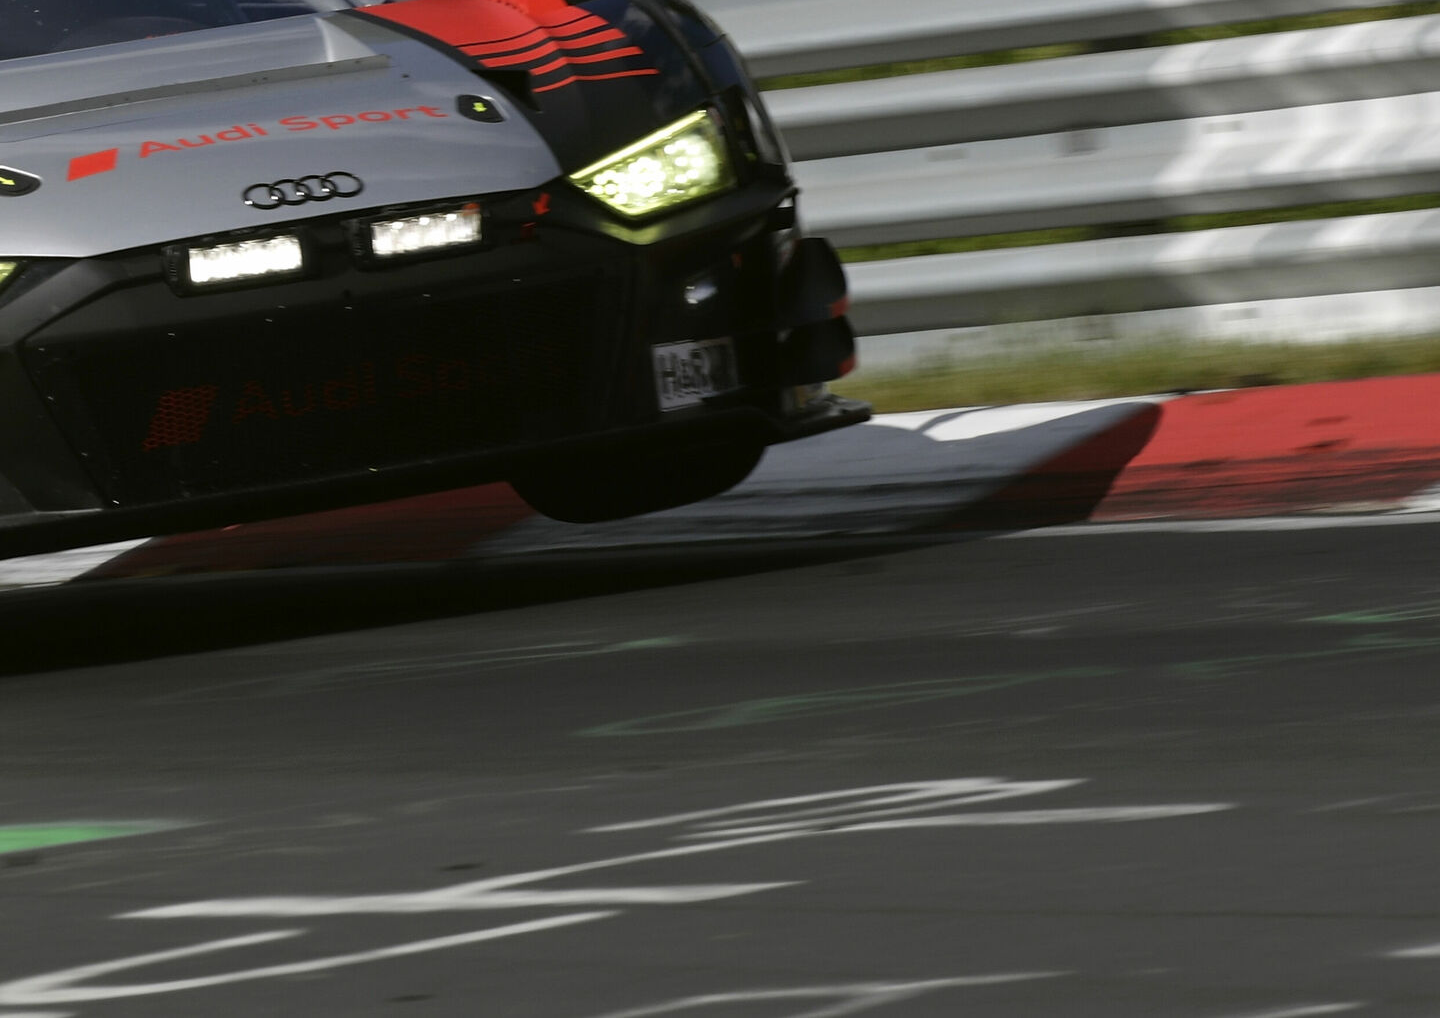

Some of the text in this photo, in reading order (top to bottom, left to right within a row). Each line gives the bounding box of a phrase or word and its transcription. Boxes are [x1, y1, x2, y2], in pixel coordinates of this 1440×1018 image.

[139, 105, 449, 159] Audi Sport
[231, 359, 377, 424] Audi
